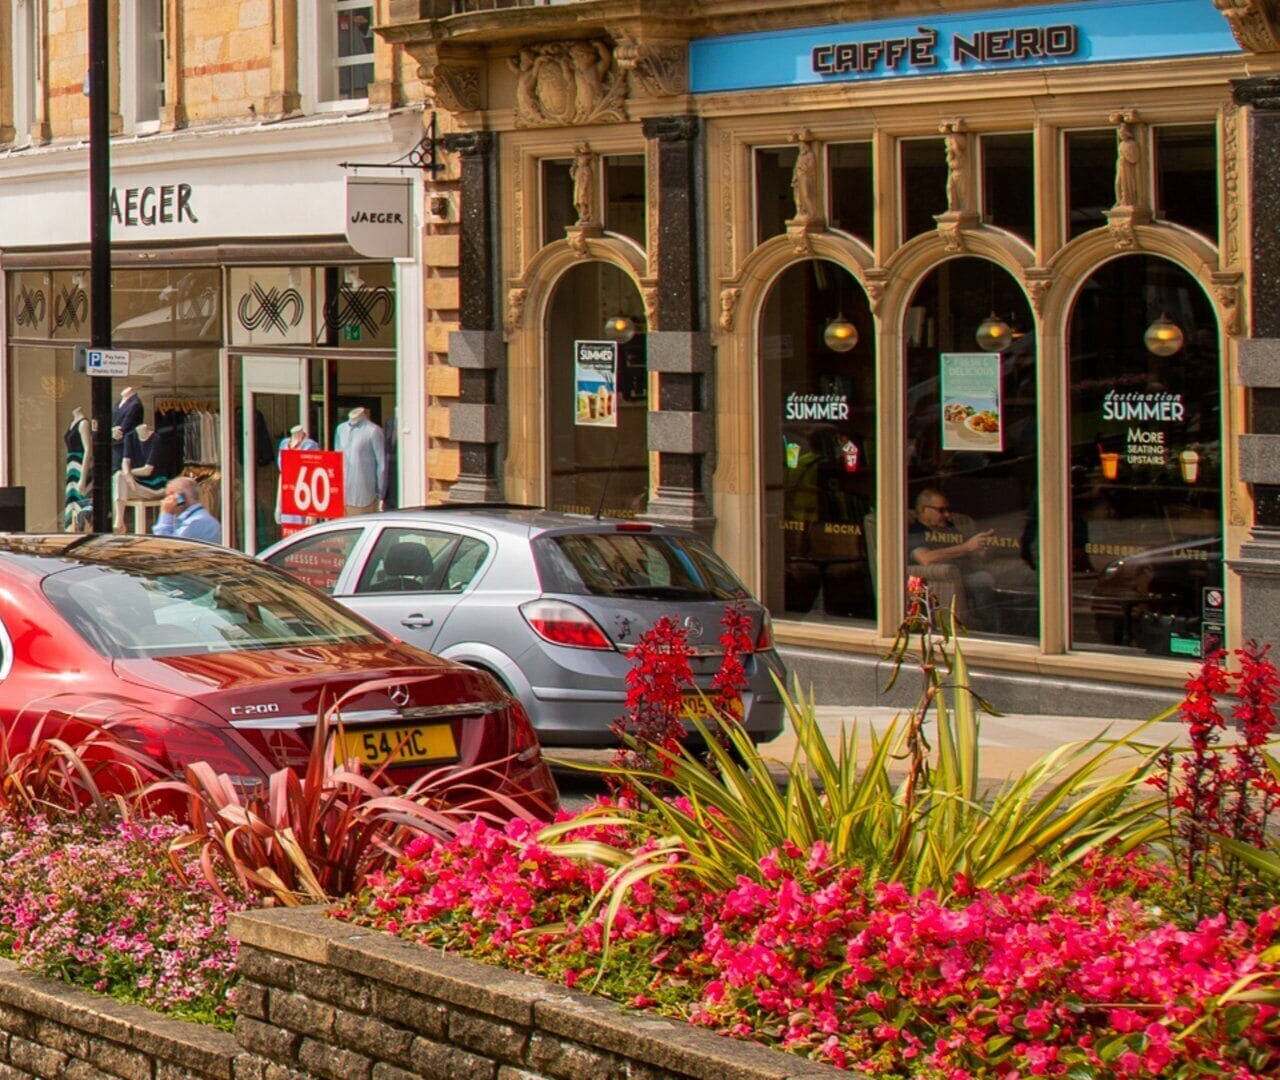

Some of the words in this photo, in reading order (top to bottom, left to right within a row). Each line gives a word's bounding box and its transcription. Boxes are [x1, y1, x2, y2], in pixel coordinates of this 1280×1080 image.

[812, 26, 938, 74] CAFFÈ
[953, 23, 1078, 64] NERO
[110, 183, 199, 227] AEGER
[351, 211, 404, 225] JAEGER
[787, 392, 847, 402] destination
[1104, 389, 1182, 402] destination
[786, 403, 849, 420] SUMMER
[1103, 402, 1184, 421] SUMMER
[1128, 445, 1165, 454] SEATING
[1128, 455, 1166, 465] UPSTAIRS
[363, 732, 392, 760] 54
[397, 729, 428, 757] HC
